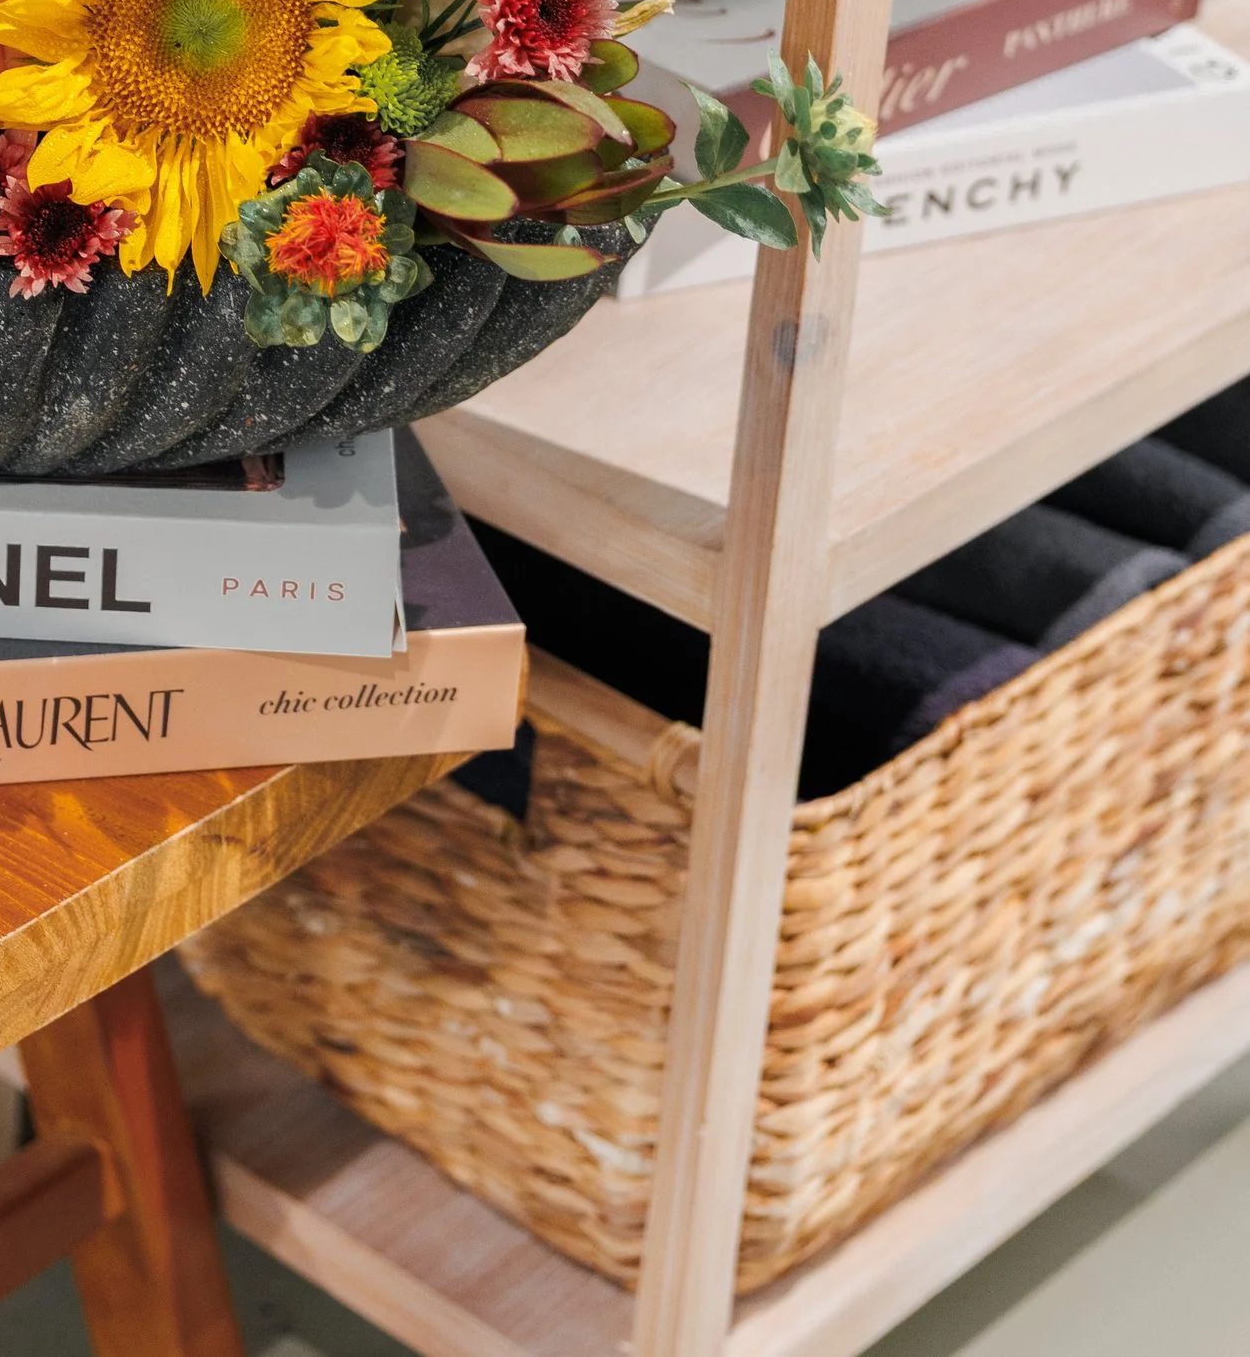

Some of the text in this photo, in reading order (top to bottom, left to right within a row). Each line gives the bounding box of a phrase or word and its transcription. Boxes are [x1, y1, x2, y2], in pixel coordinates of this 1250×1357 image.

[881, 160, 1081, 228] ENCHY
[221, 576, 347, 603] PARIS
[259, 690, 317, 716] chic
[323, 682, 458, 712] collection
